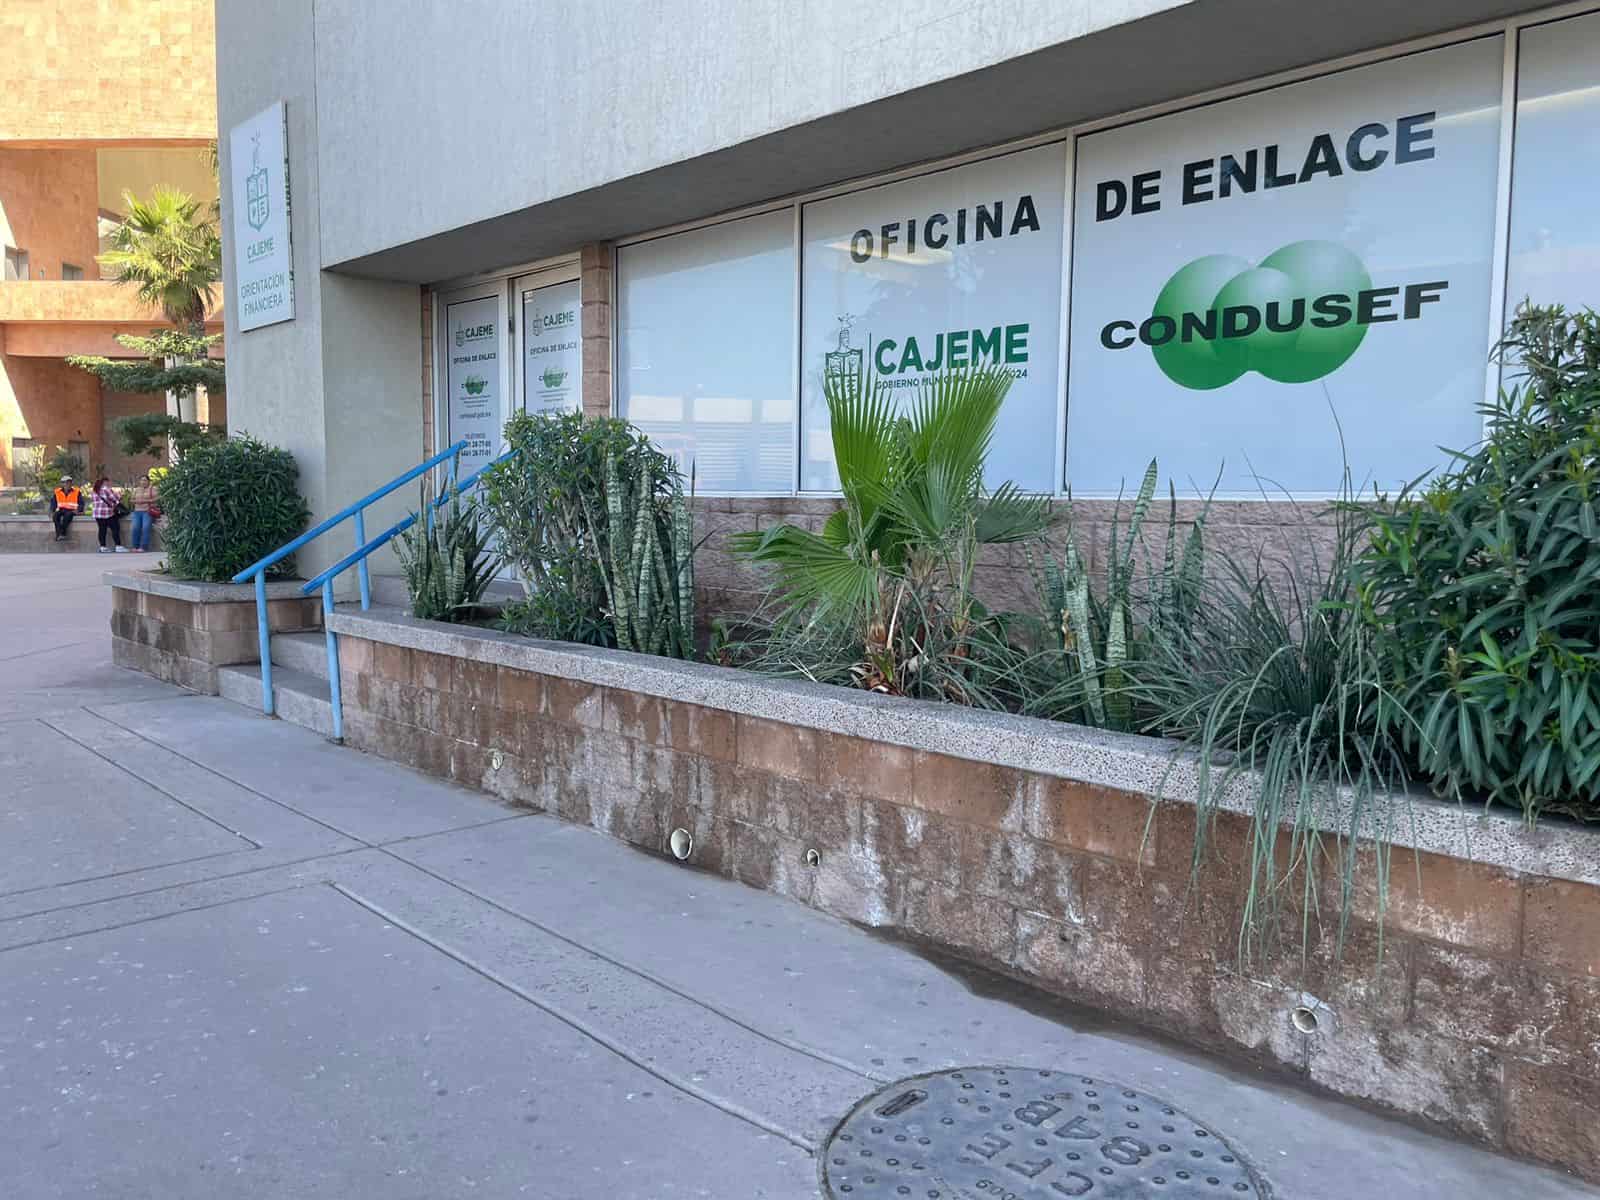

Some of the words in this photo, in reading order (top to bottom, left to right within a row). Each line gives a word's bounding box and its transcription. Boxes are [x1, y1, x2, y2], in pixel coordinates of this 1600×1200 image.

[850, 195, 1041, 264] OFICINA
[1096, 171, 1162, 222] DE
[1182, 111, 1437, 206] ENLACE
[247, 238, 273, 259] CAJEME
[244, 292, 284, 316] FINANCIERA
[1100, 281, 1449, 350] CONDUSEF
[465, 324, 494, 338] CAJEME
[544, 311, 575, 327] CAJEME
[875, 323, 1030, 376] CAJEME
[876, 376, 919, 390] GOBIERNO
[966, 1132, 1094, 1197] CFE
